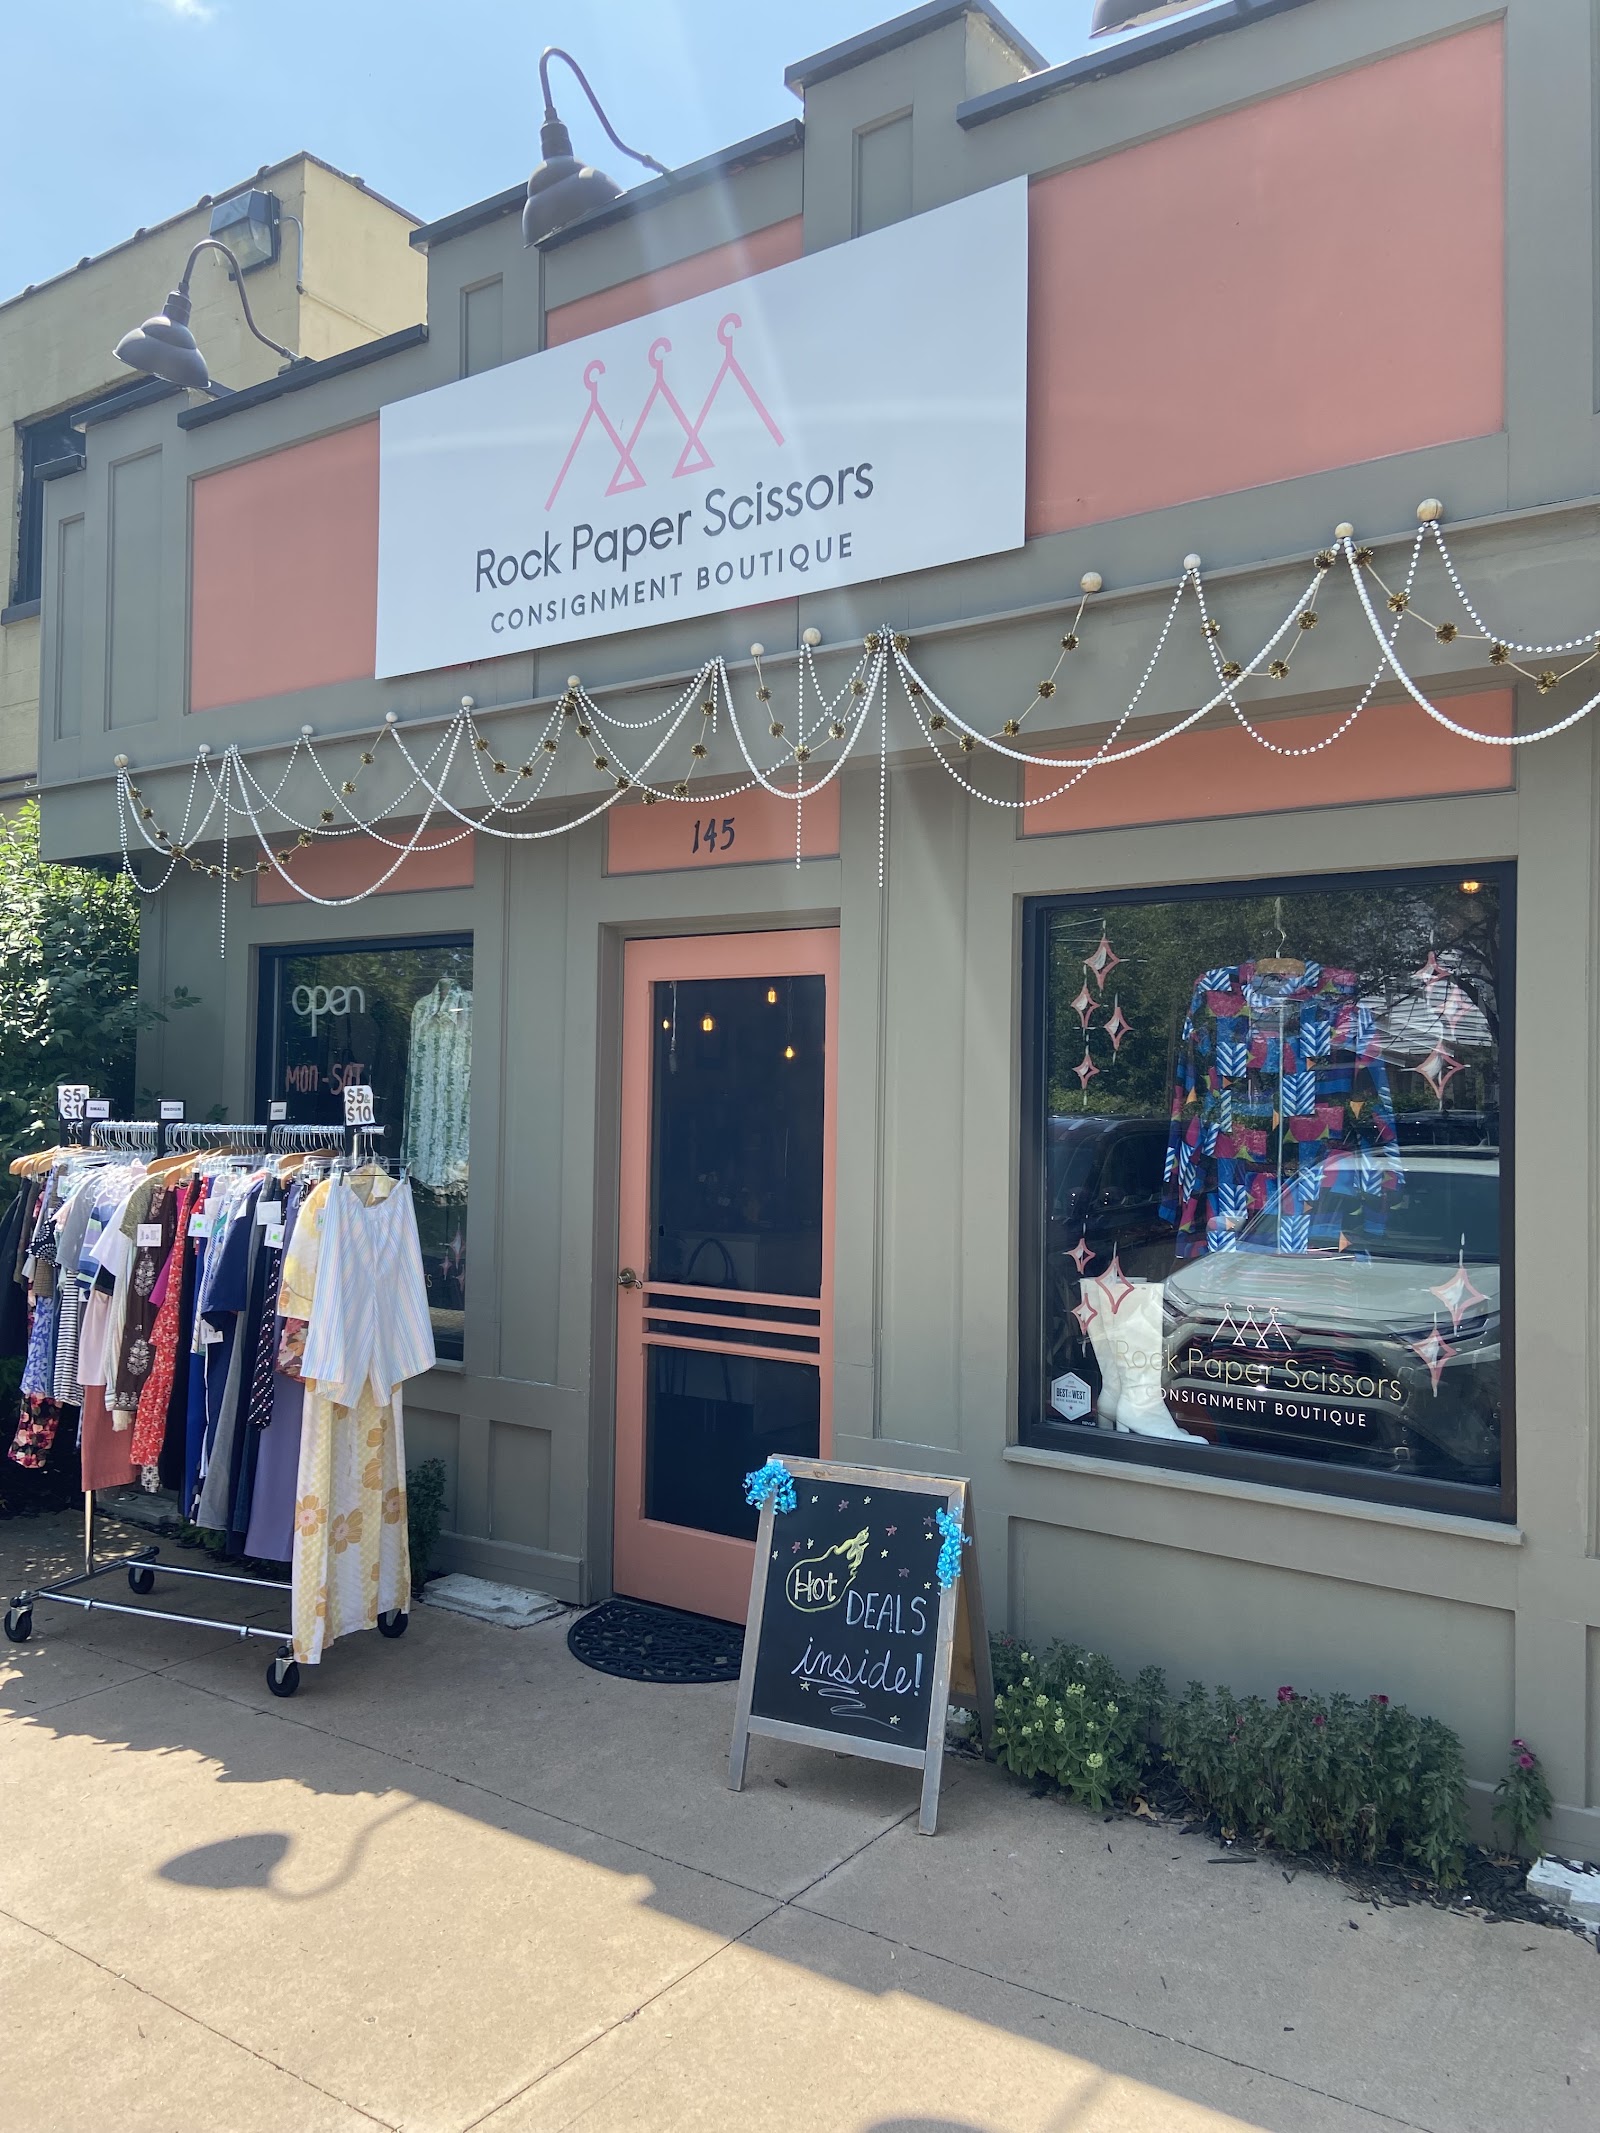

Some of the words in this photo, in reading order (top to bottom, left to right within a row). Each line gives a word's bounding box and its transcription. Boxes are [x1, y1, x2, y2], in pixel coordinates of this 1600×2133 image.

[476, 530, 563, 593] Rock
[571, 509, 692, 572] Paper
[702, 462, 874, 537] Scissors
[491, 572, 683, 634] CONSIGNMENT
[696, 531, 852, 591] BOUTIQUE
[692, 817, 735, 854] 145
[292, 985, 365, 1038] open
[63, 1088, 81, 1103] $5
[285, 1064, 319, 1093] MON
[330, 1062, 365, 1095] SAT
[347, 1105, 372, 1123] $10
[1116, 1340, 1178, 1374] Rock
[1188, 1347, 1275, 1388] Paper
[1284, 1359, 1402, 1401] Scissors
[1056, 1388, 1068, 1398] BEST
[1072, 1390, 1086, 1400] WEST
[1274, 1402, 1366, 1427] BOUTIQUE
[794, 1569, 837, 1602] Hot
[845, 1589, 927, 1636] DEALS
[791, 1637, 923, 1696] inside!
